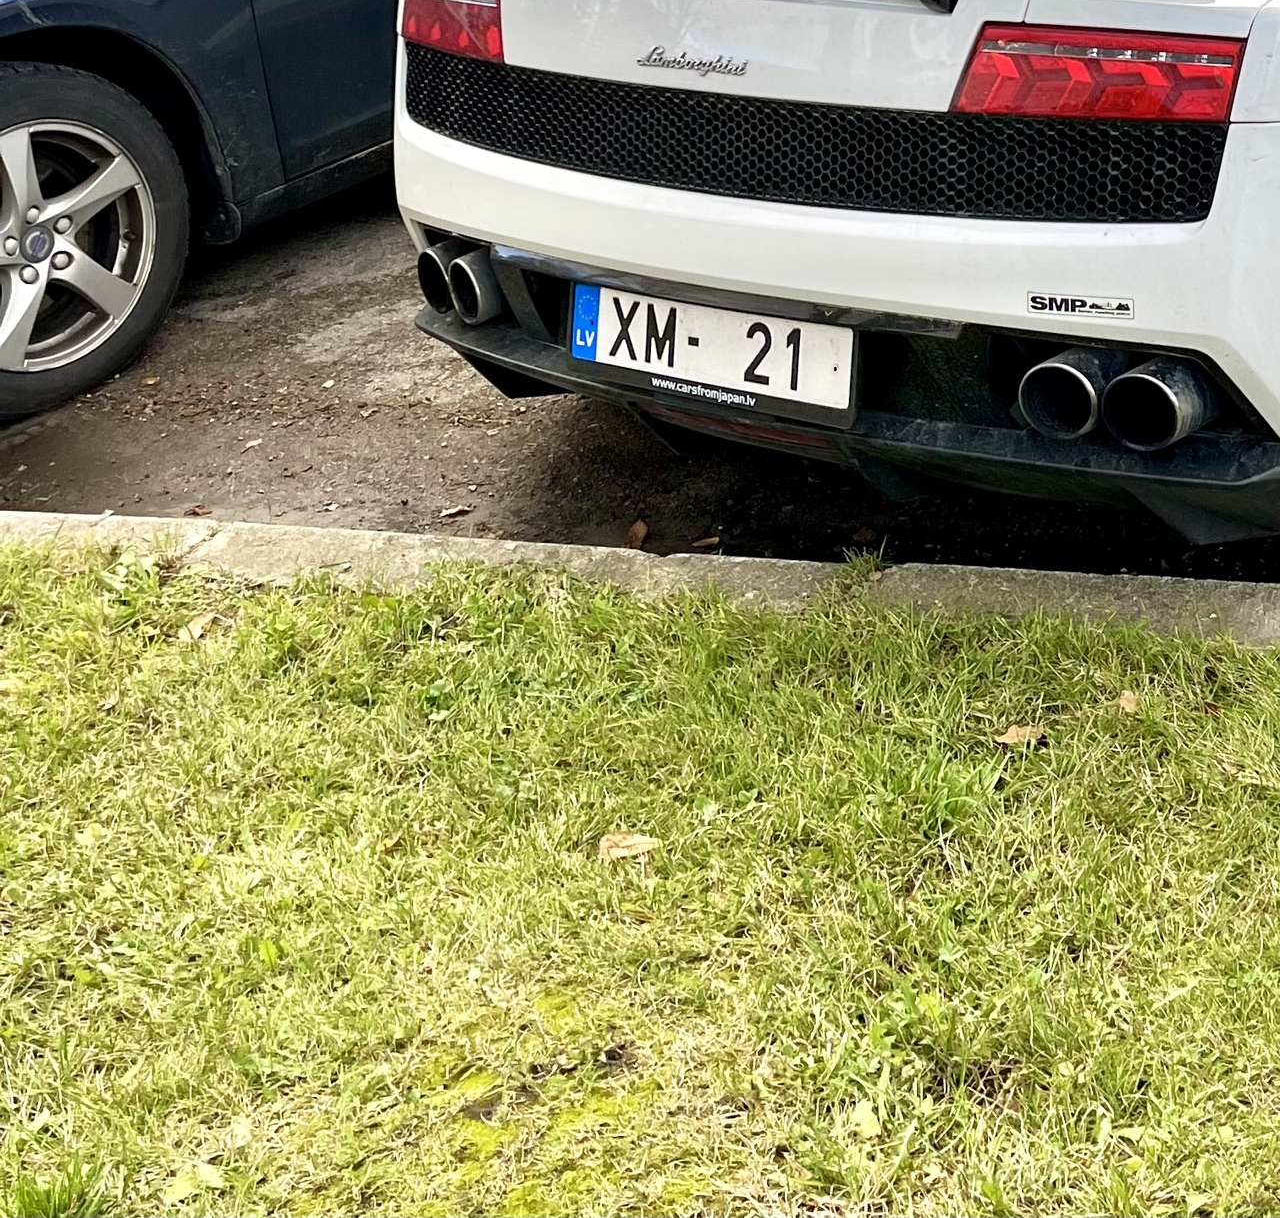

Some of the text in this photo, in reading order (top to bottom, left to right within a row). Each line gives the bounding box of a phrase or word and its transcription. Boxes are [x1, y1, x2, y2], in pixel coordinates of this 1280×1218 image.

[636, 45, 749, 77] Lamborghini
[1030, 295, 1088, 313] SMP
[576, 329, 595, 348] LV
[743, 322, 802, 391] 21
[651, 377, 757, 407] www.carsfromjapan.lv
